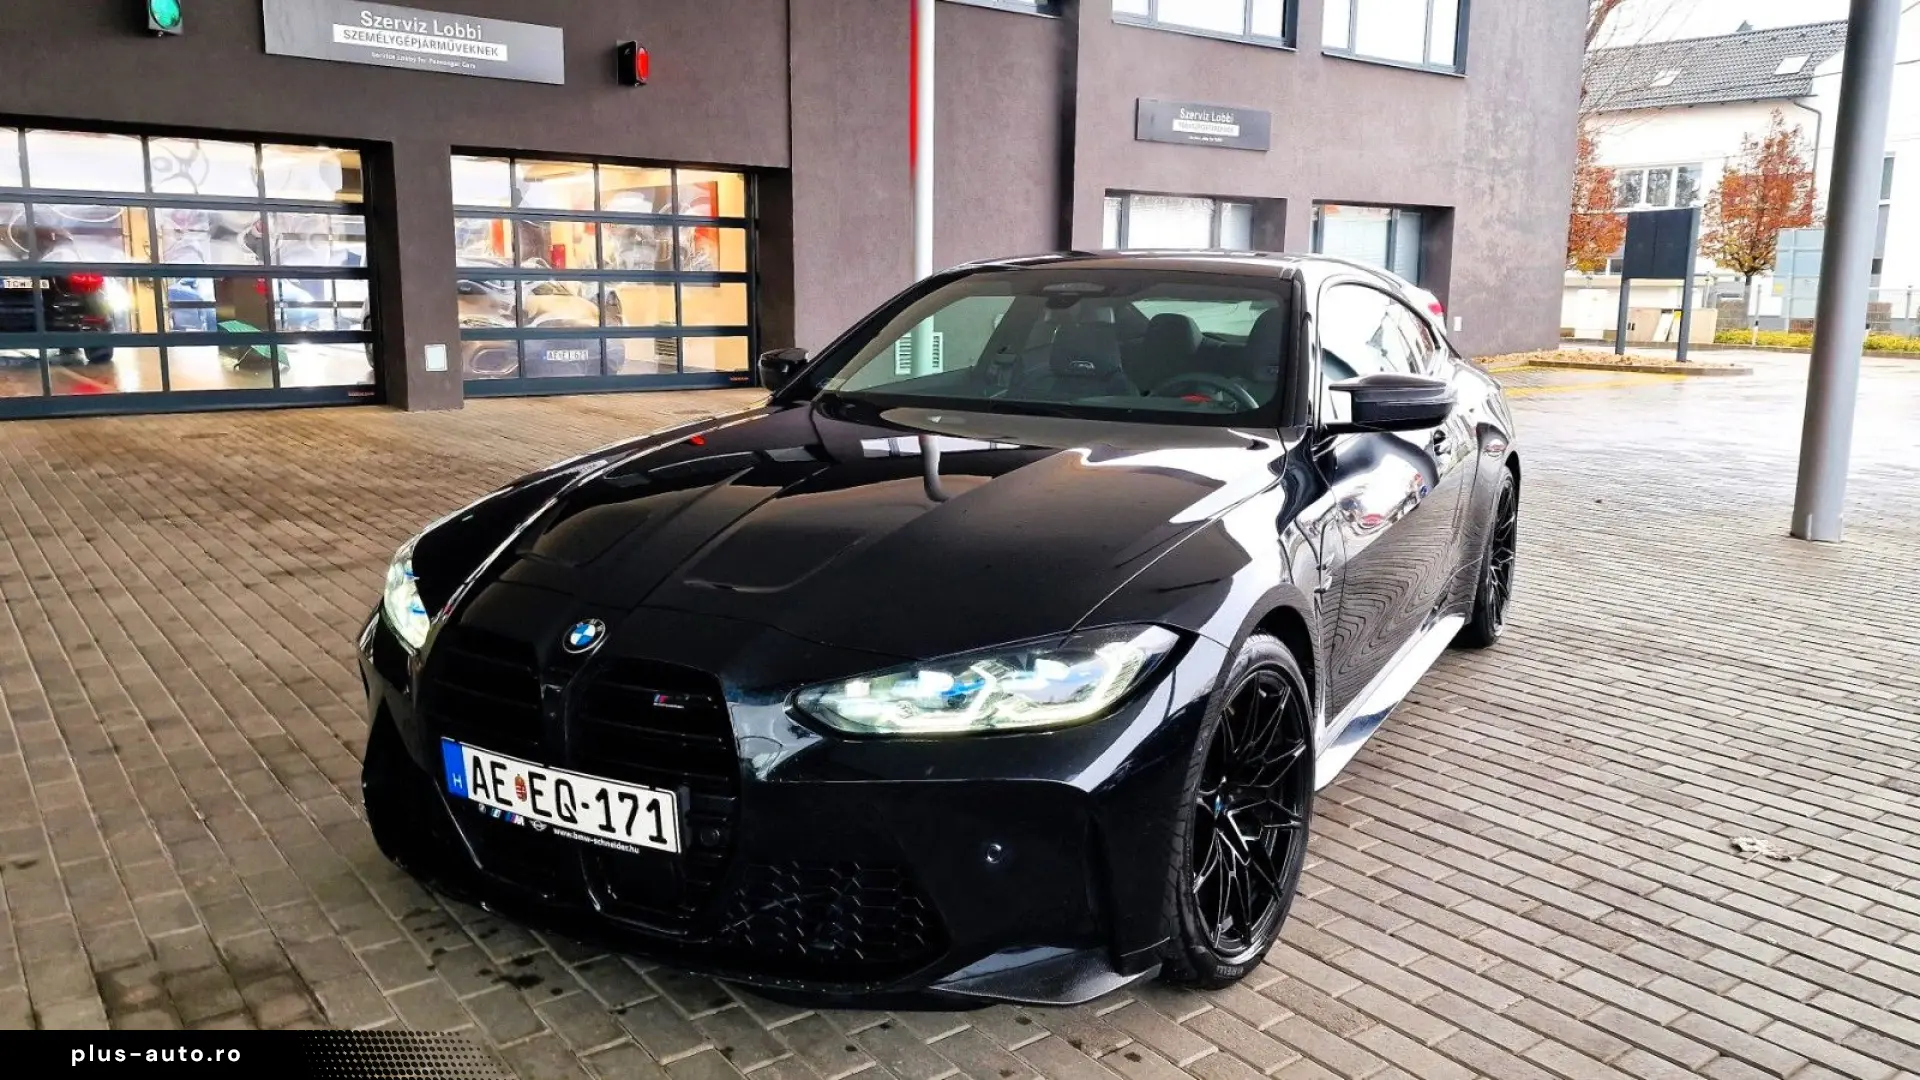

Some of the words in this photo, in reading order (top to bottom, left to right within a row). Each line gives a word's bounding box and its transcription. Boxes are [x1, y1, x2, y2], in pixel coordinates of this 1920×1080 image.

[360, 10, 428, 34] Szerviz
[433, 19, 482, 41] Lobbi
[1180, 107, 1209, 121] Szerviz
[1211, 111, 1235, 123] Lobbi
[452, 772, 463, 790] H
[472, 755, 513, 807] AE
[527, 770, 668, 845] EQ-171
[552, 827, 641, 855] www.bmw-schneider.hu
